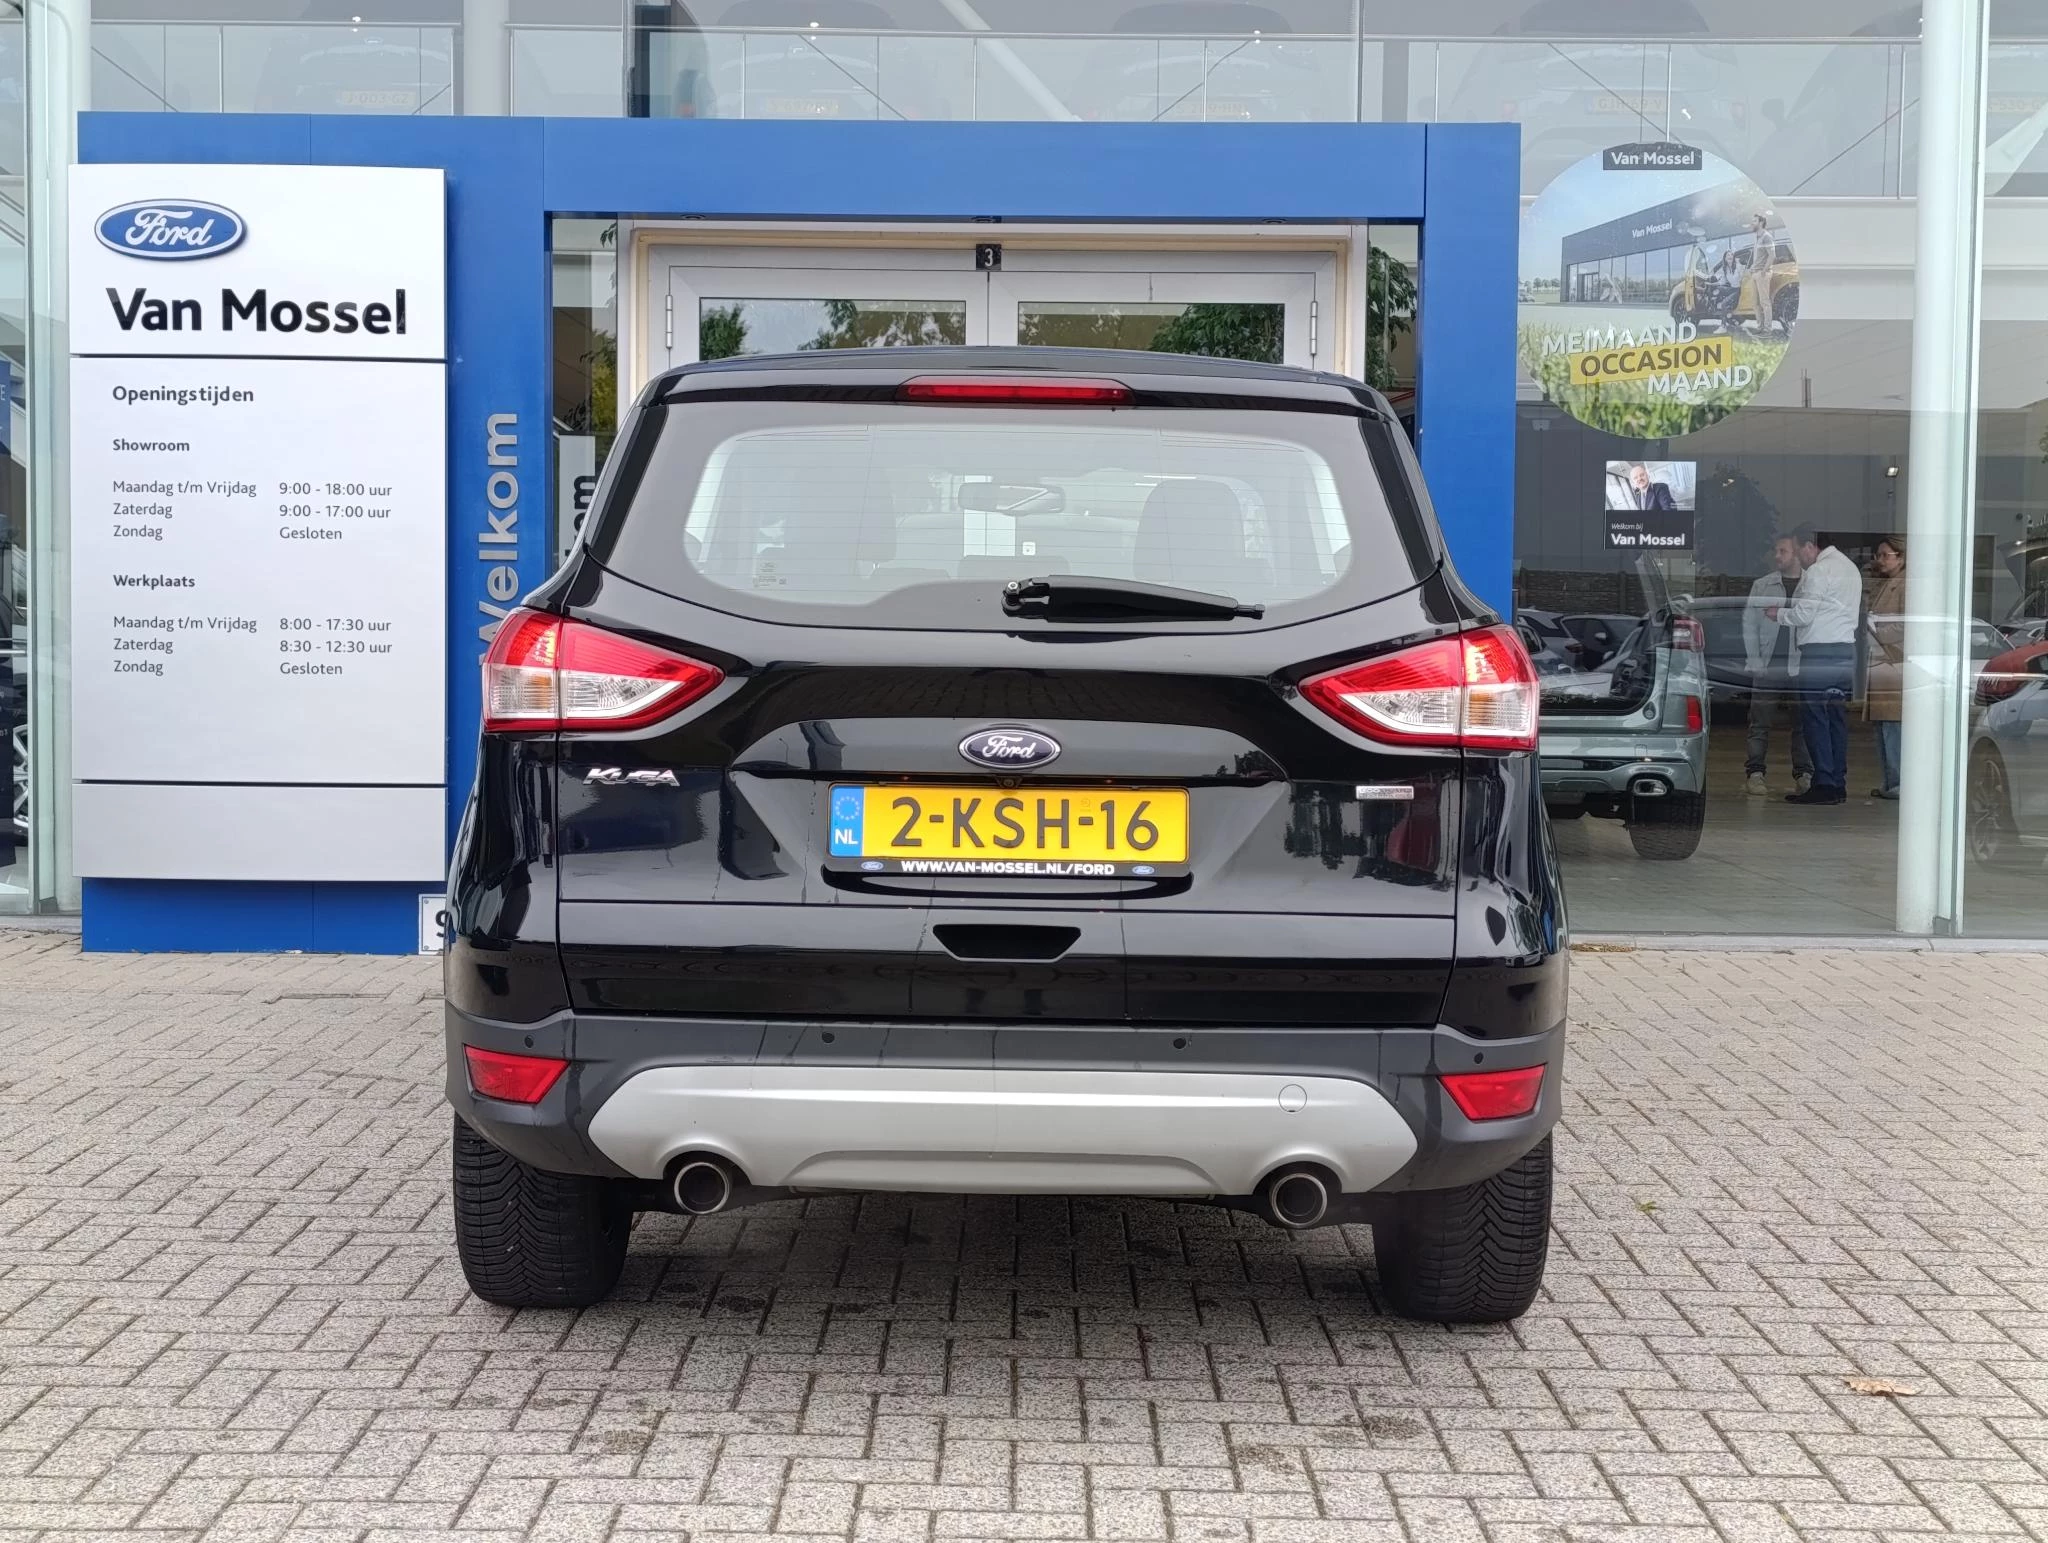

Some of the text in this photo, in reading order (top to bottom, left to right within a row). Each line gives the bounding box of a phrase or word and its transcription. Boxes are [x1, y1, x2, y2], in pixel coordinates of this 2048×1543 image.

[1611, 151, 1695, 165] Van Mossel
[125, 208, 215, 247] Ford
[1632, 218, 1673, 238] Van Mossel
[983, 248, 994, 267] 3
[106, 287, 407, 335] Van Mossel
[1542, 321, 1697, 357] MEIMAAND
[1580, 344, 1723, 377] OCCASION
[1647, 364, 1754, 396] MAAND
[112, 386, 255, 406] Openingstijden
[112, 438, 190, 452] Showroom
[113, 480, 257, 498] Maandag t/m Vrijdag
[279, 482, 311, 495] 9:00
[325, 483, 365, 496] 18:00
[369, 486, 393, 496] uur
[113, 502, 173, 519] Zaterdag
[279, 504, 311, 517] 9:00
[325, 505, 364, 518] 17:00
[367, 508, 392, 518] uur
[113, 525, 163, 541] Zondag
[279, 527, 342, 540] Gesloten
[1611, 533, 1685, 546] Van Mossel
[113, 574, 196, 591] Werkplaats
[113, 615, 257, 633] Maandag t/m Vrijdag
[279, 618, 312, 631] 8:00
[326, 618, 364, 631] 17:30
[368, 622, 392, 631] uur
[113, 637, 174, 654] Zaterdag
[279, 640, 312, 653] 8:30
[326, 640, 365, 653] 12:30
[369, 644, 393, 653] uur
[113, 659, 164, 677] Zondag
[279, 662, 343, 675] Gesloten
[982, 735, 1037, 759] Ford
[890, 796, 1160, 851] 2-KSH-16
[834, 828, 859, 846] NL
[901, 860, 1115, 876] WWW.VAN-MOSSEL.NL/FORD
